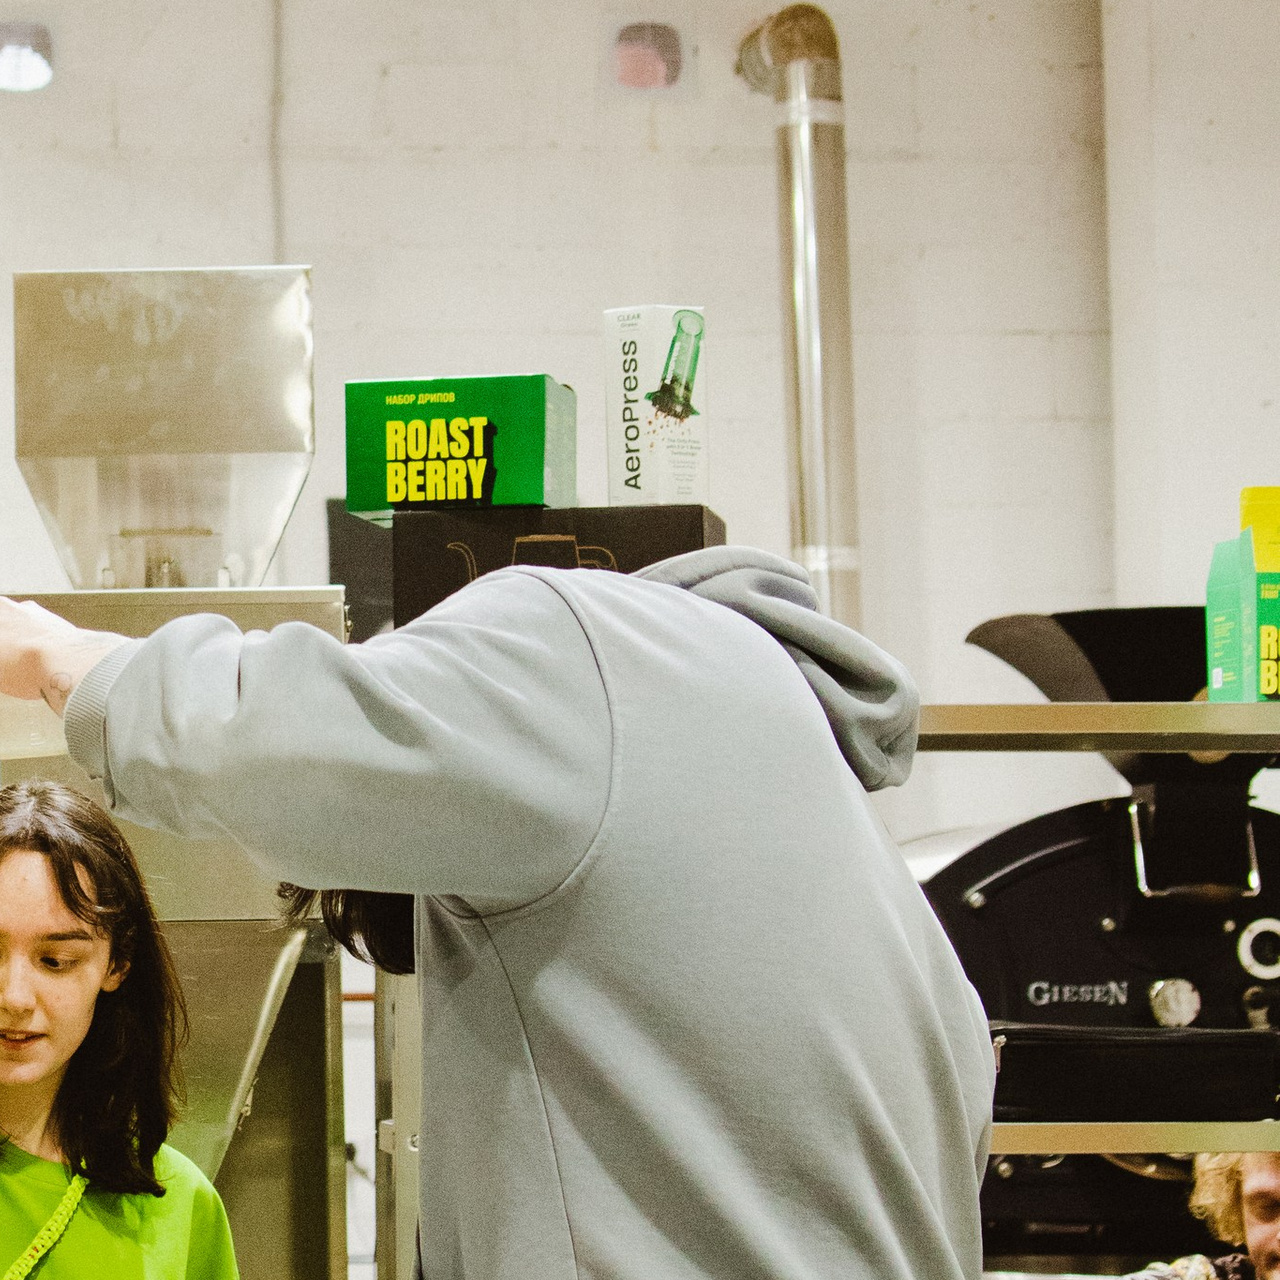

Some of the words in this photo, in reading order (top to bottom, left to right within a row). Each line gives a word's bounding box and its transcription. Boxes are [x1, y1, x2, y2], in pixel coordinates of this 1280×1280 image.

[385, 394, 417, 405] НАБОР
[417, 392, 455, 404] ДРИПОВ
[622, 340, 641, 490] AeroPress
[386, 417, 488, 460] ROAST
[386, 458, 488, 502] BERRY
[1027, 980, 1129, 1007] GIESEN
